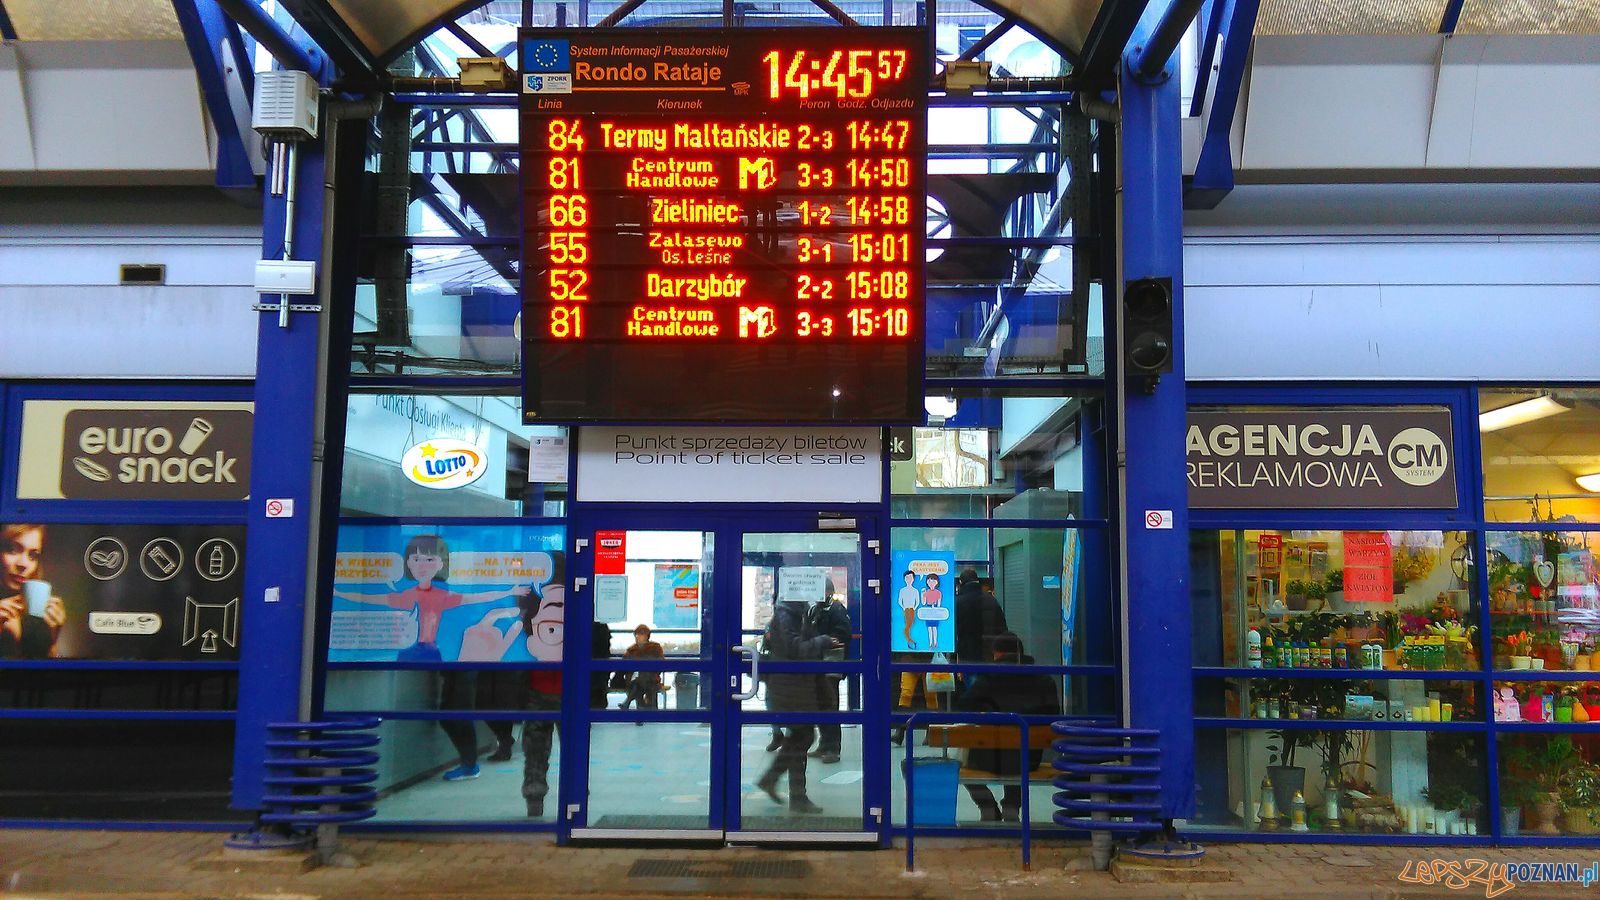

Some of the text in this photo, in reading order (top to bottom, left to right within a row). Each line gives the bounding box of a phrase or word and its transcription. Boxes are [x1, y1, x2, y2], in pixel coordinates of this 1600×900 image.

[569, 46, 729, 58] System Informacji Pasażerskiej
[575, 62, 722, 85] Rondo Rataje
[762, 50, 906, 98] 14:45 57
[538, 99, 562, 109] Linia
[657, 99, 702, 109] Kierunek
[800, 99, 830, 109] Peron
[838, 98, 914, 110] Godz. Odjazdu
[548, 120, 910, 150] 84 Termy Maltańskie 2-3 14:47
[548, 157, 580, 189] 81
[632, 158, 712, 172] Centrum
[798, 158, 908, 188] 3-3 14:50
[626, 173, 718, 188] Handlowe
[548, 195, 908, 226] 66 Zieliniec 1-2 14:58
[550, 232, 587, 263] 55
[648, 232, 742, 248] Zalasewo
[798, 234, 908, 262] 3-1 15:01
[662, 247, 732, 264] Os. Leśne
[550, 270, 908, 300] 52 Darzybór 2-2 15:08
[551, 306, 581, 337] 81
[633, 306, 714, 322] Centrum
[798, 308, 908, 336] 3-3 15:10
[628, 322, 718, 336] Handlowe
[78, 426, 174, 454] euro
[614, 434, 867, 452] Punkt sprzedaży biletów
[1186, 424, 1384, 456] AGENCJA
[117, 450, 236, 484] snack
[425, 455, 466, 476] LOTTO
[614, 450, 866, 464] Point of ticket sale
[1390, 444, 1442, 468] CM
[1186, 462, 1382, 488] REKLAMOWA
